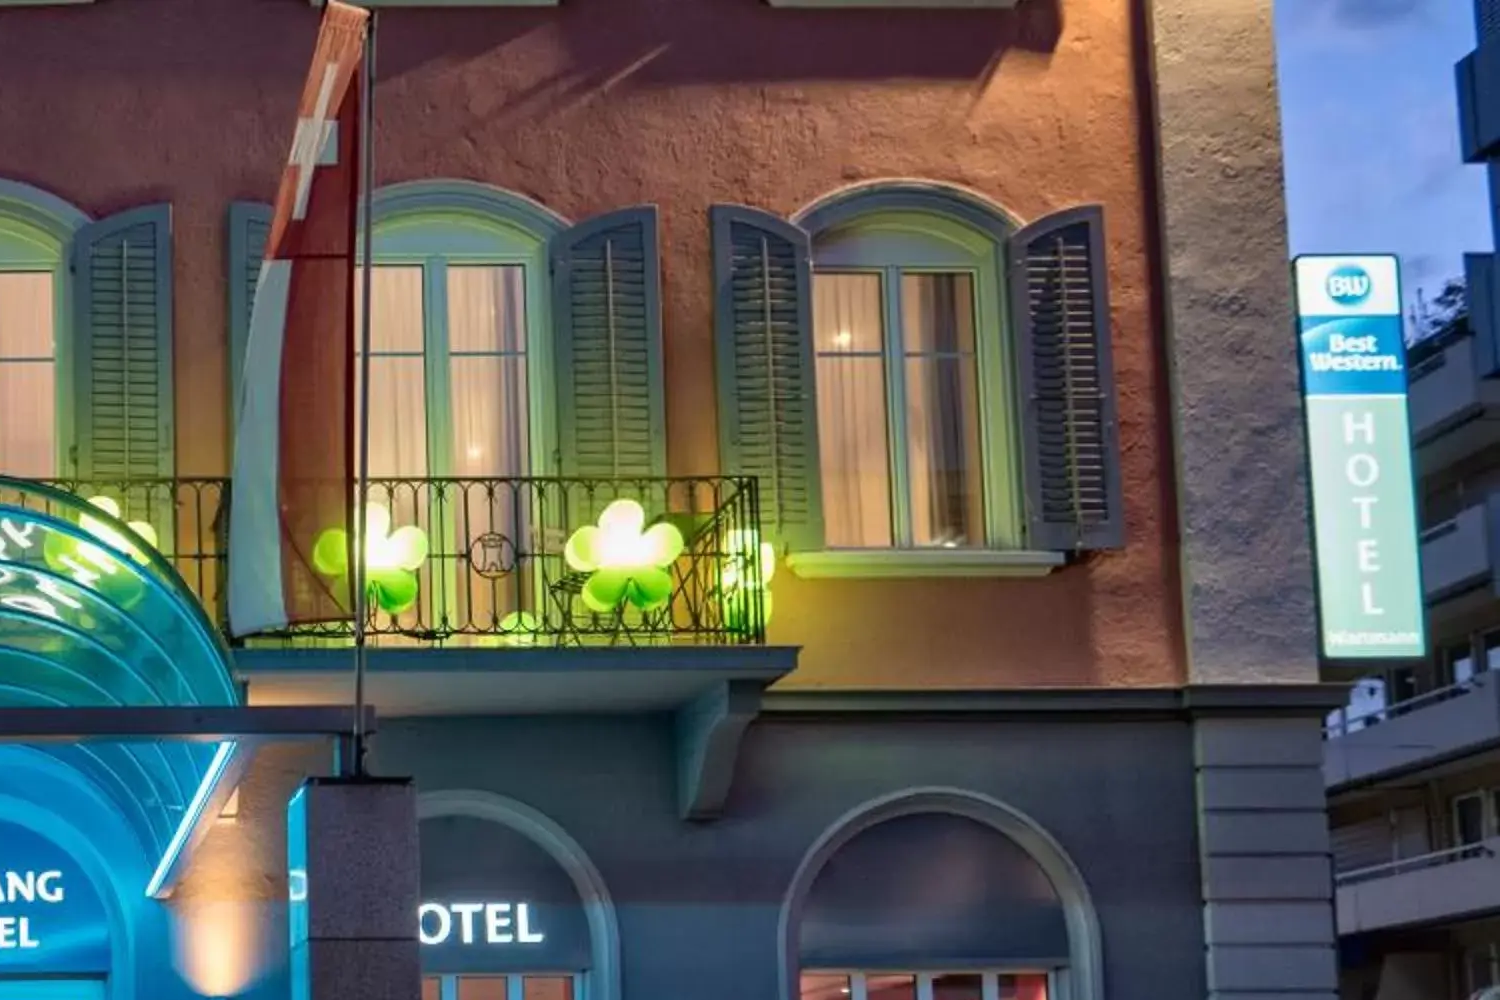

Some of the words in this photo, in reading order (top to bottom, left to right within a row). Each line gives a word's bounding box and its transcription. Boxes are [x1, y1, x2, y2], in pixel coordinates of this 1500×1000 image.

[1329, 274, 1369, 297] BW
[1329, 333, 1378, 353] Best
[1343, 411, 1384, 616] HOTEL
